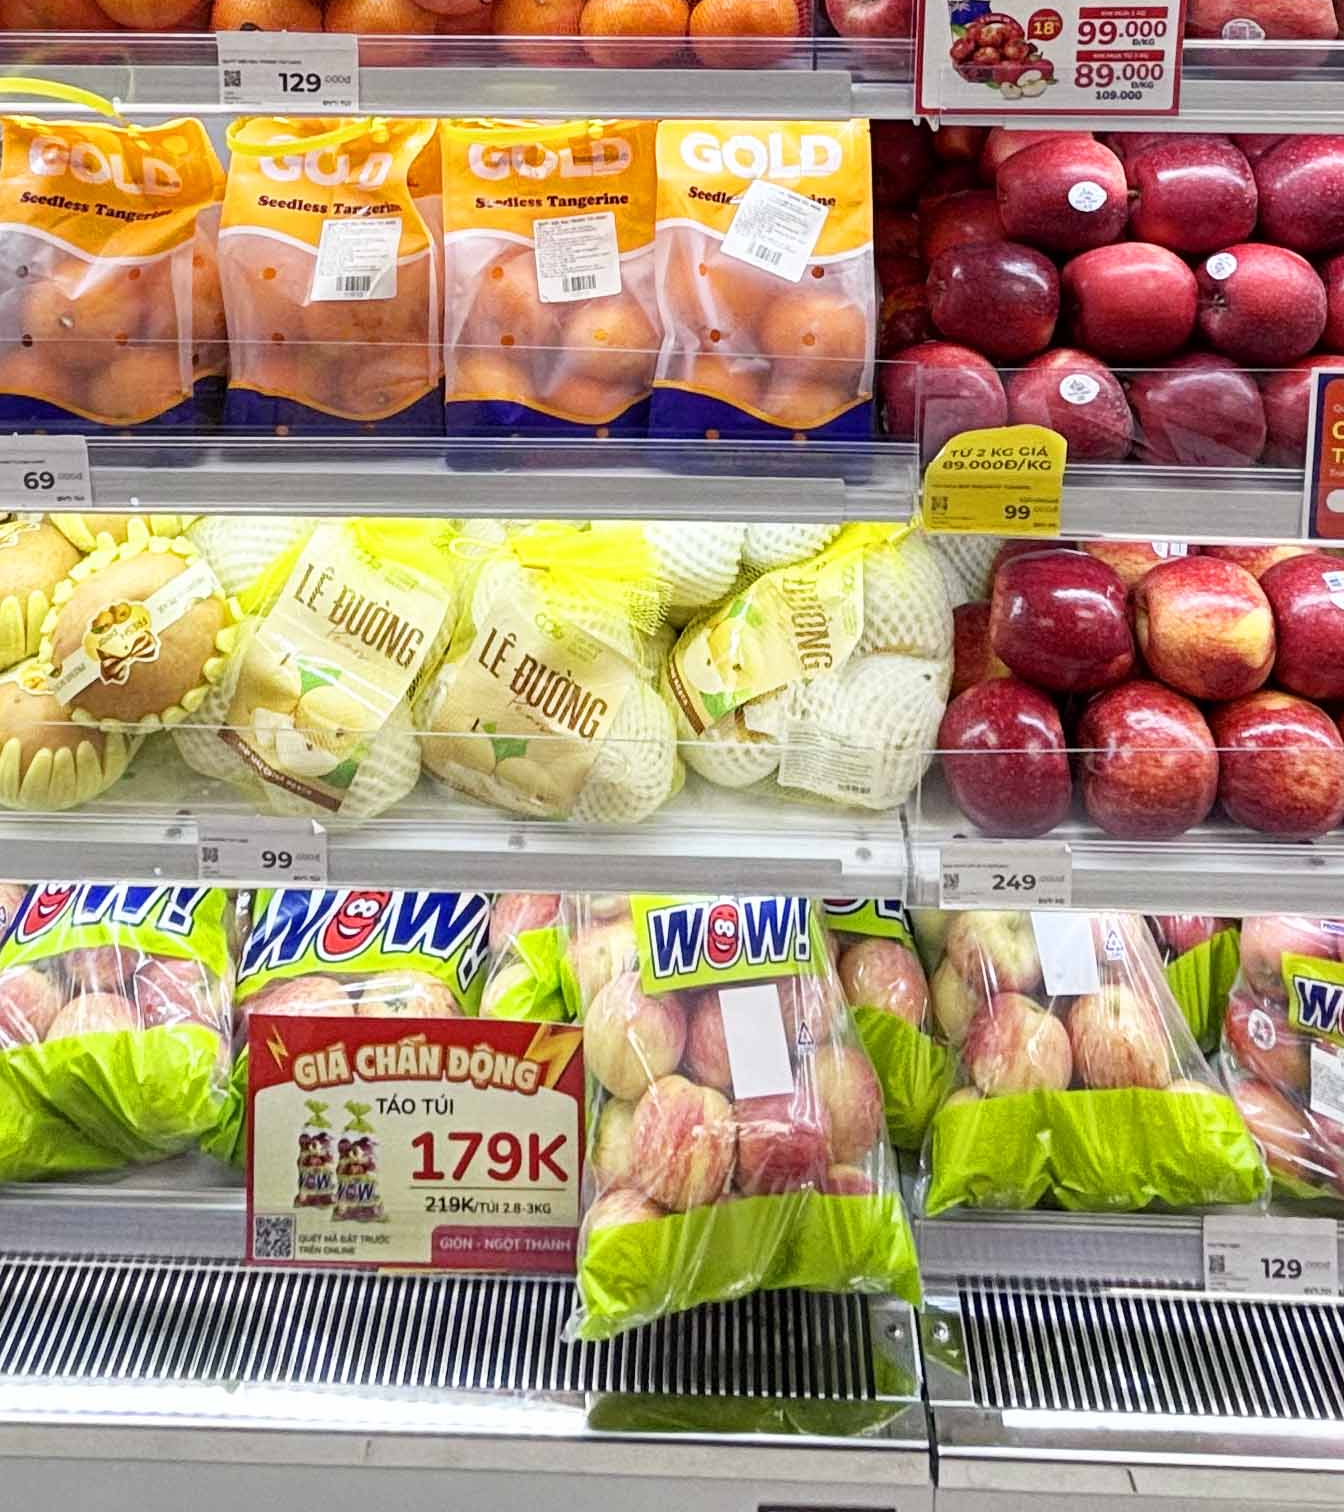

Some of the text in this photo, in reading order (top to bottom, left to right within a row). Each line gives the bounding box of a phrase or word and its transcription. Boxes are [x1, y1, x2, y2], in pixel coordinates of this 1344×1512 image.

[1077, 20, 1167, 45] 99.000
[278, 72, 322, 94] 129
[1074, 63, 1164, 88] 89.000
[1095, 91, 1142, 100] 109.000
[28, 134, 183, 197] GOLD
[468, 135, 633, 181] GOLD
[680, 131, 843, 179] GOLD
[19, 190, 90, 213] Seedless
[256, 194, 329, 215] Seedless
[547, 192, 630, 211] Tangerine
[975, 448, 987, 458] 2
[990, 447, 1014, 457] KG
[1018, 444, 1049, 457] GIÁ
[23, 469, 56, 491] 69
[1004, 504, 1031, 520] 99
[293, 562, 425, 670] LÊ ĐƯỜNG
[478, 626, 608, 740] LÊ ĐƯỜNG
[260, 850, 293, 870] 99
[991, 873, 1037, 893] 249
[647, 895, 812, 979] WOW!
[294, 1033, 540, 1092] GIÁ CHẤN ĐỘNG
[376, 1094, 455, 1115] TÁO TÚI
[411, 1131, 569, 1182] 179K
[1259, 1257, 1302, 1281] 129
